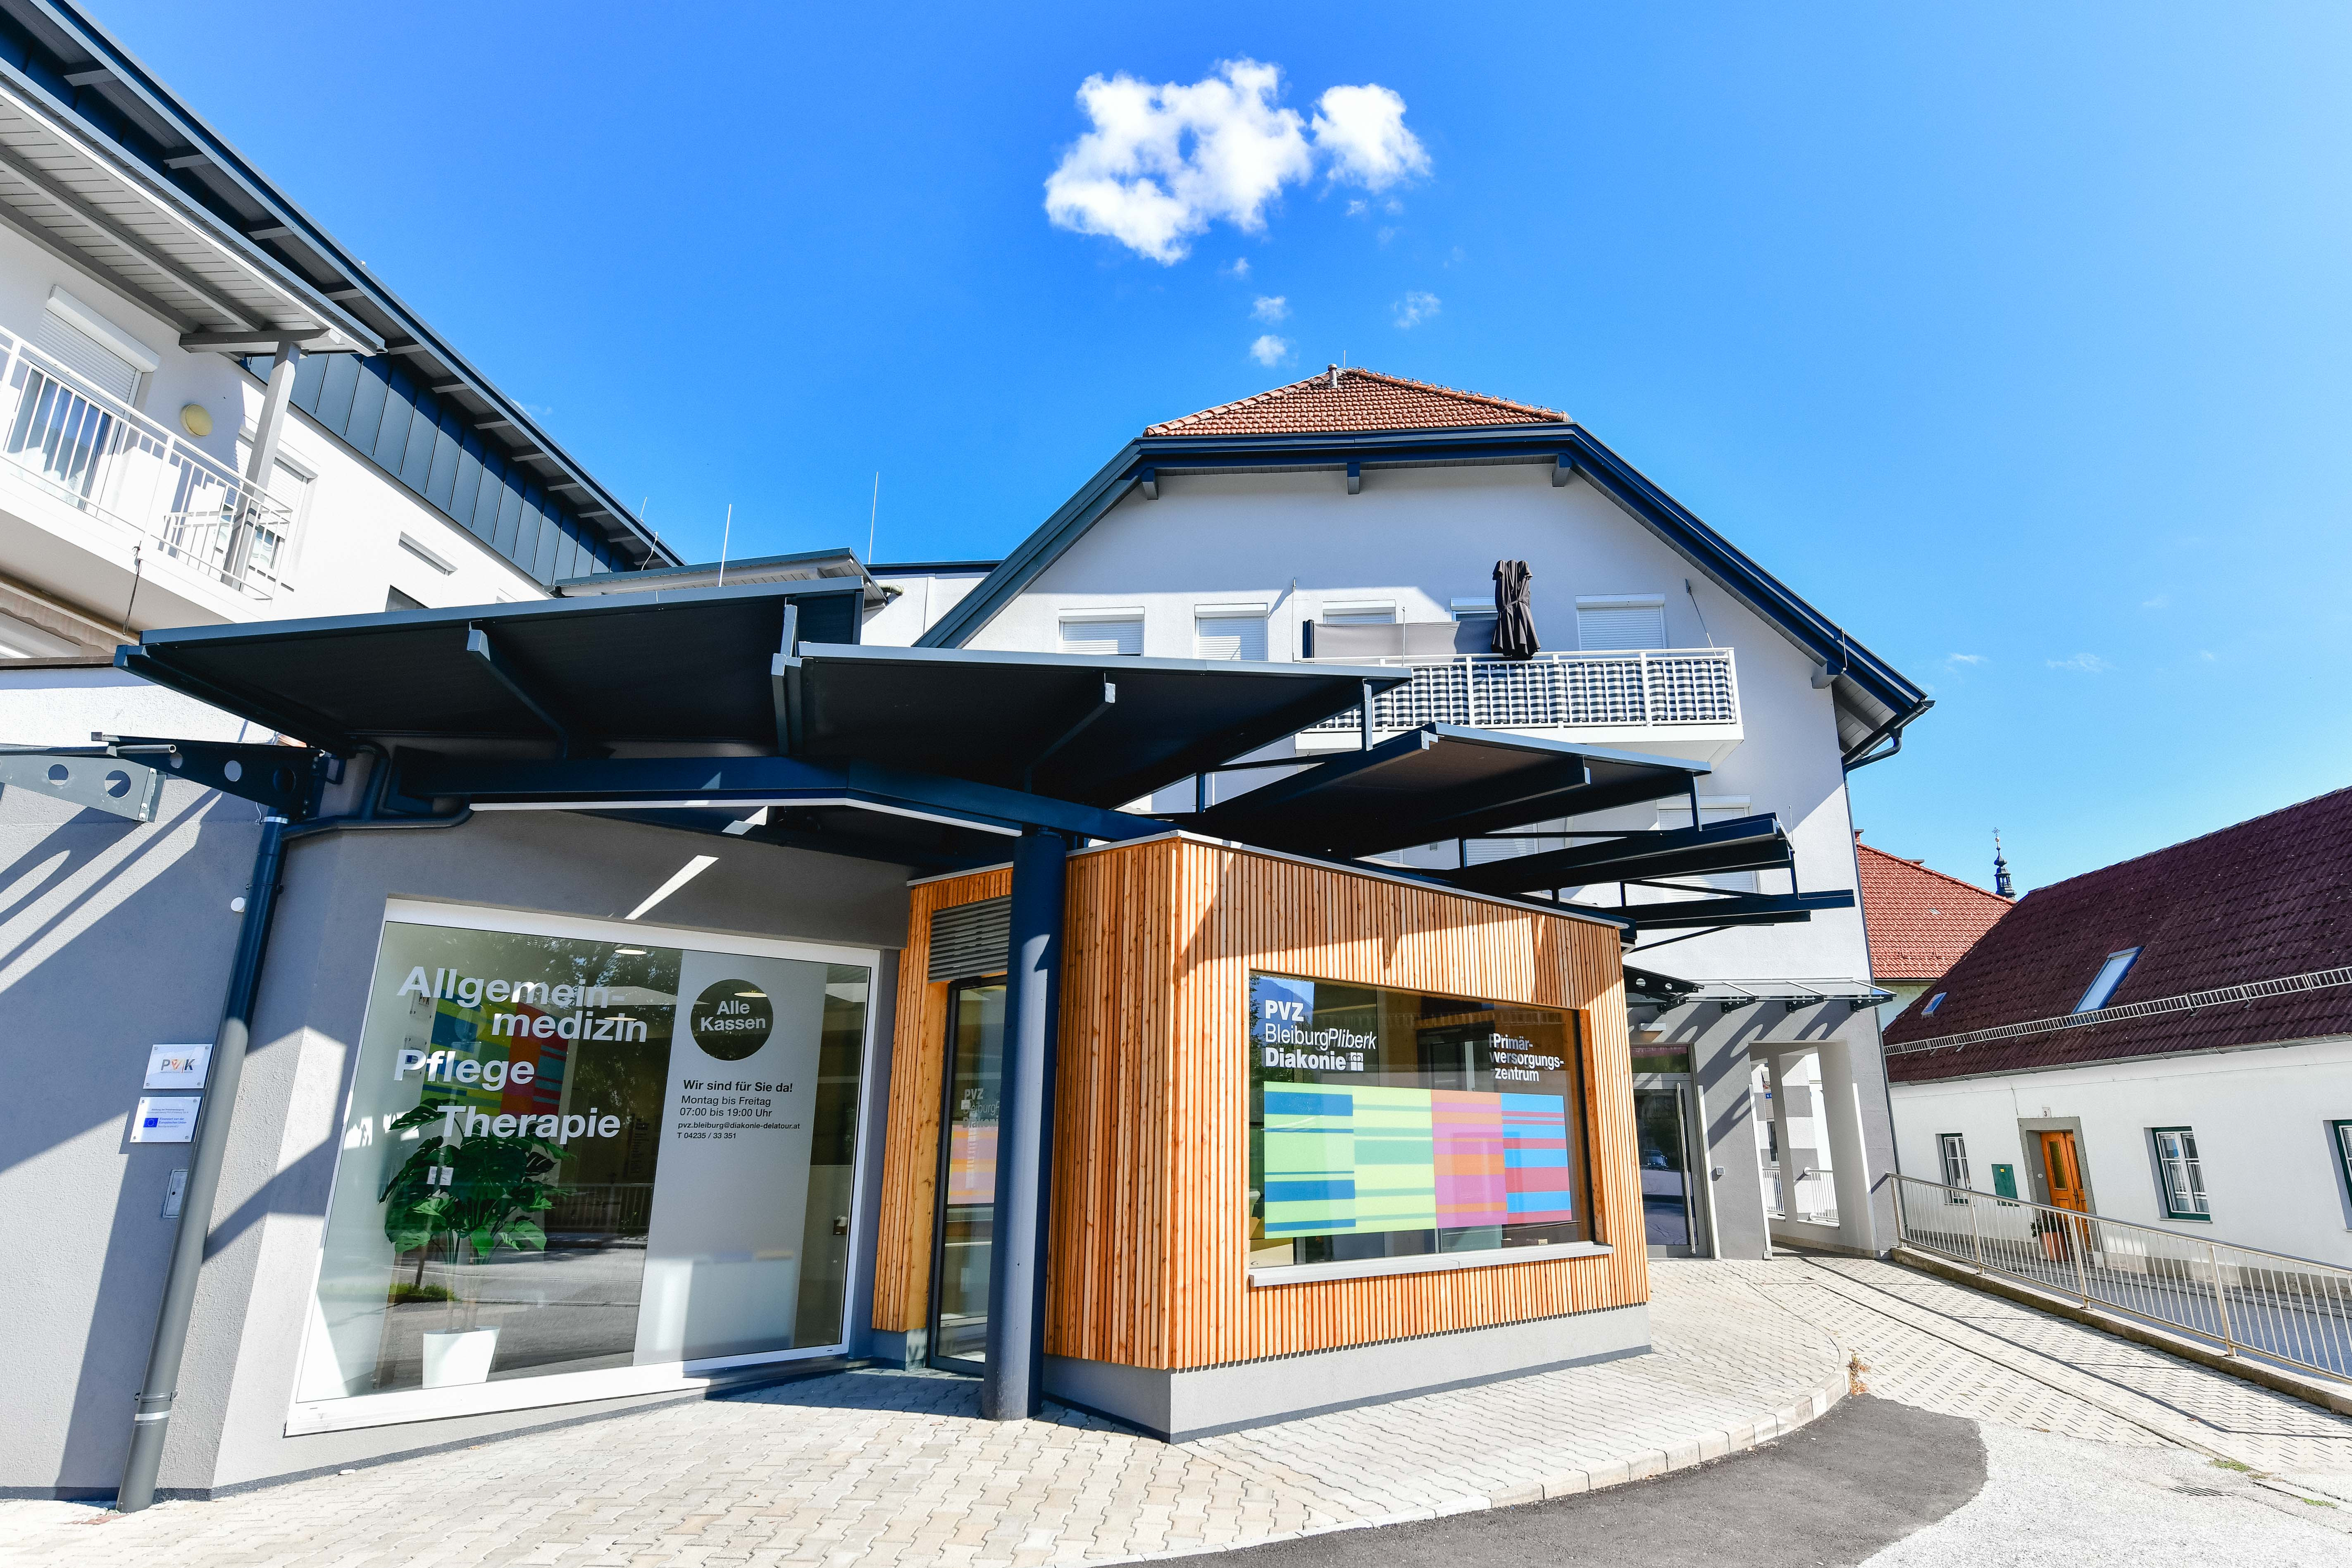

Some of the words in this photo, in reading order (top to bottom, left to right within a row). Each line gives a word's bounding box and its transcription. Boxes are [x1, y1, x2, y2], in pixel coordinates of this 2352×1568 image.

[397, 966, 625, 1009] Allgemein-
[716, 1000, 750, 1015] Alle
[1265, 999, 1304, 1022] PVZ
[492, 1010, 648, 1042] medizin
[701, 1016, 766, 1032] Kassen
[1493, 1033, 1533, 1051] Primär-
[1265, 1047, 1346, 1071] Diakonie
[1494, 1051, 1564, 1071] versorgungs-
[394, 1049, 535, 1091] Pflege
[1495, 1066, 1539, 1082] zentrum
[683, 1079, 704, 1090] Wir
[707, 1081, 732, 1091] sind
[735, 1081, 752, 1091] für
[755, 1082, 772, 1092] Sie
[775, 1083, 793, 1092] da!
[964, 1088, 984, 1100] PVZ
[681, 1095, 719, 1106] Montag
[722, 1096, 736, 1105] bis
[739, 1097, 771, 1107] Freitag
[680, 1107, 707, 1116] 07:00
[710, 1108, 724, 1116] bis
[727, 1108, 753, 1117] 19:00
[755, 1109, 772, 1117] Uhr
[437, 1105, 620, 1145] Therapie
[678, 1122, 800, 1130] pvz.bleiburg@diakonie-delatour.at
